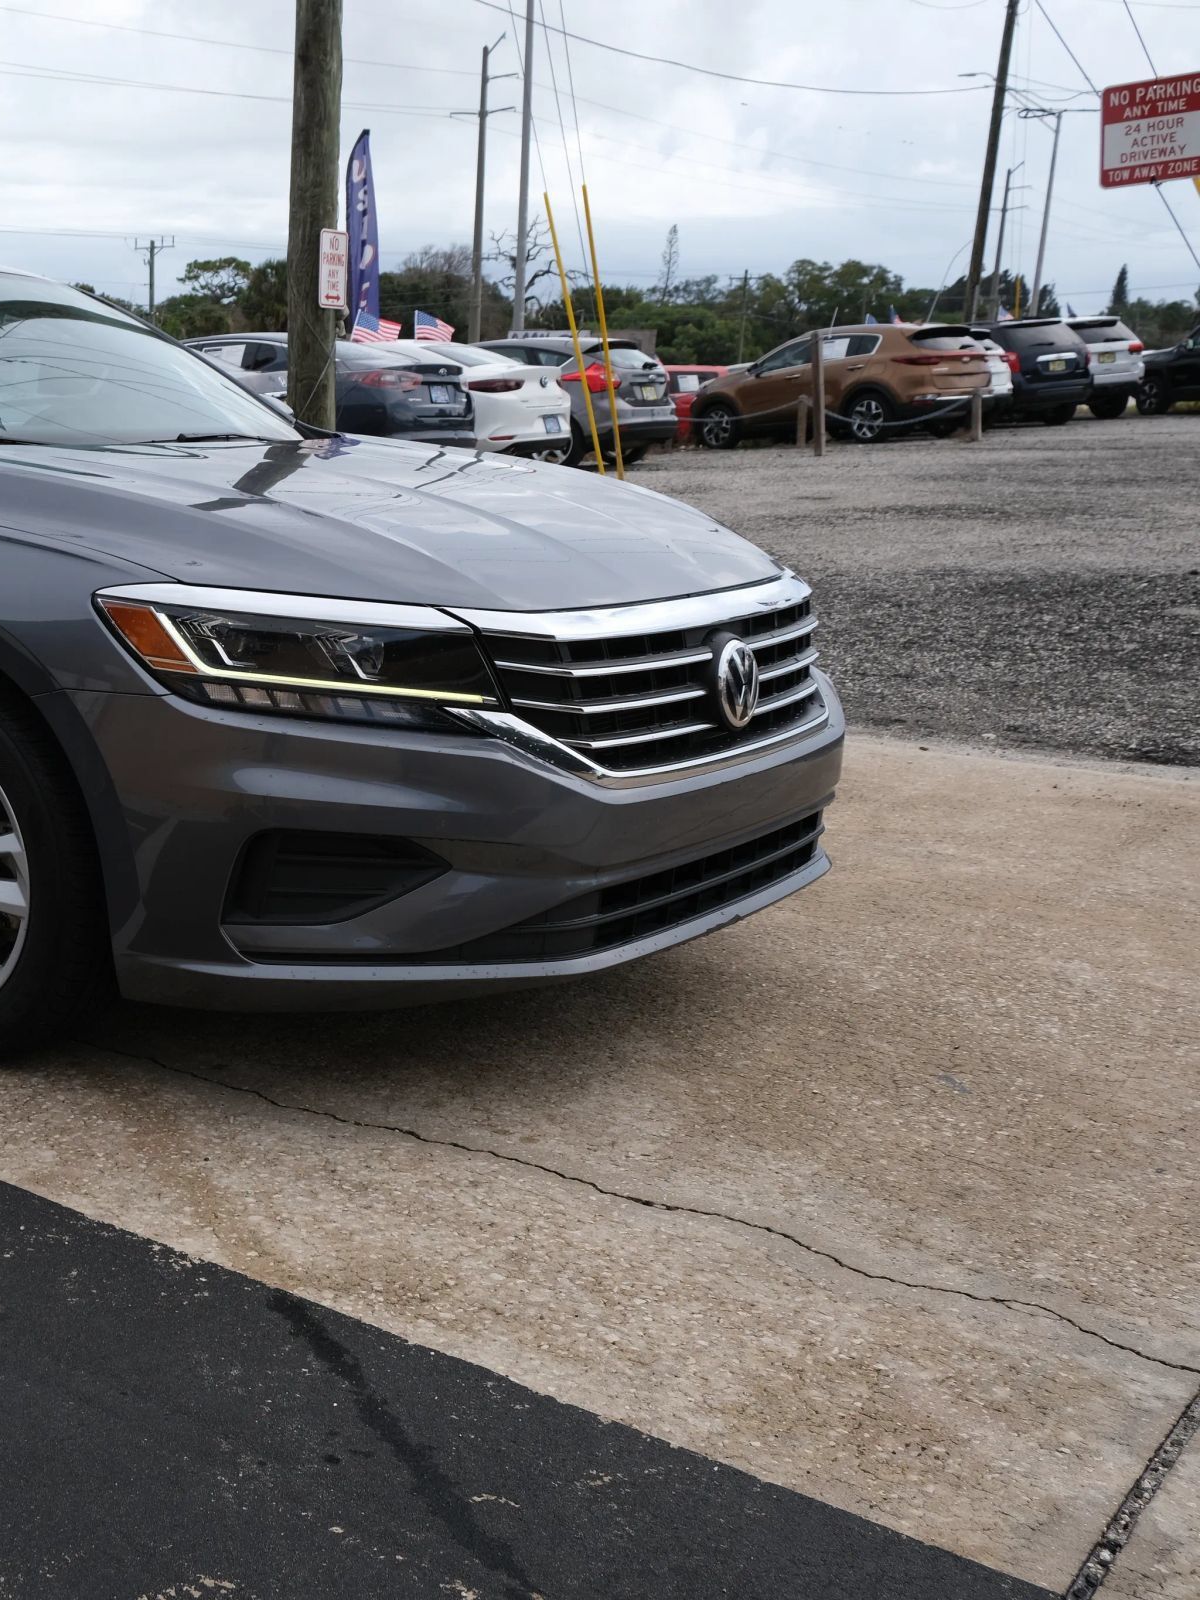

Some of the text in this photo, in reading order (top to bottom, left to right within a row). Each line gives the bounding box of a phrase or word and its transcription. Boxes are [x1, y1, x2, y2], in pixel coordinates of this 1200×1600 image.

[1109, 79, 1200, 107] NO PARKING
[1123, 98, 1187, 119] ANY TIME
[1124, 117, 1184, 136] 24 HOUR
[1131, 132, 1177, 148] ACTIVE
[1120, 144, 1187, 163] DRIVEWAY
[1107, 159, 1199, 182] TOW AWAY ZONE
[329, 238, 340, 251] NO
[323, 252, 345, 267] PARKING
[328, 269, 339, 280] ANY
[328, 280, 339, 291] TIME
